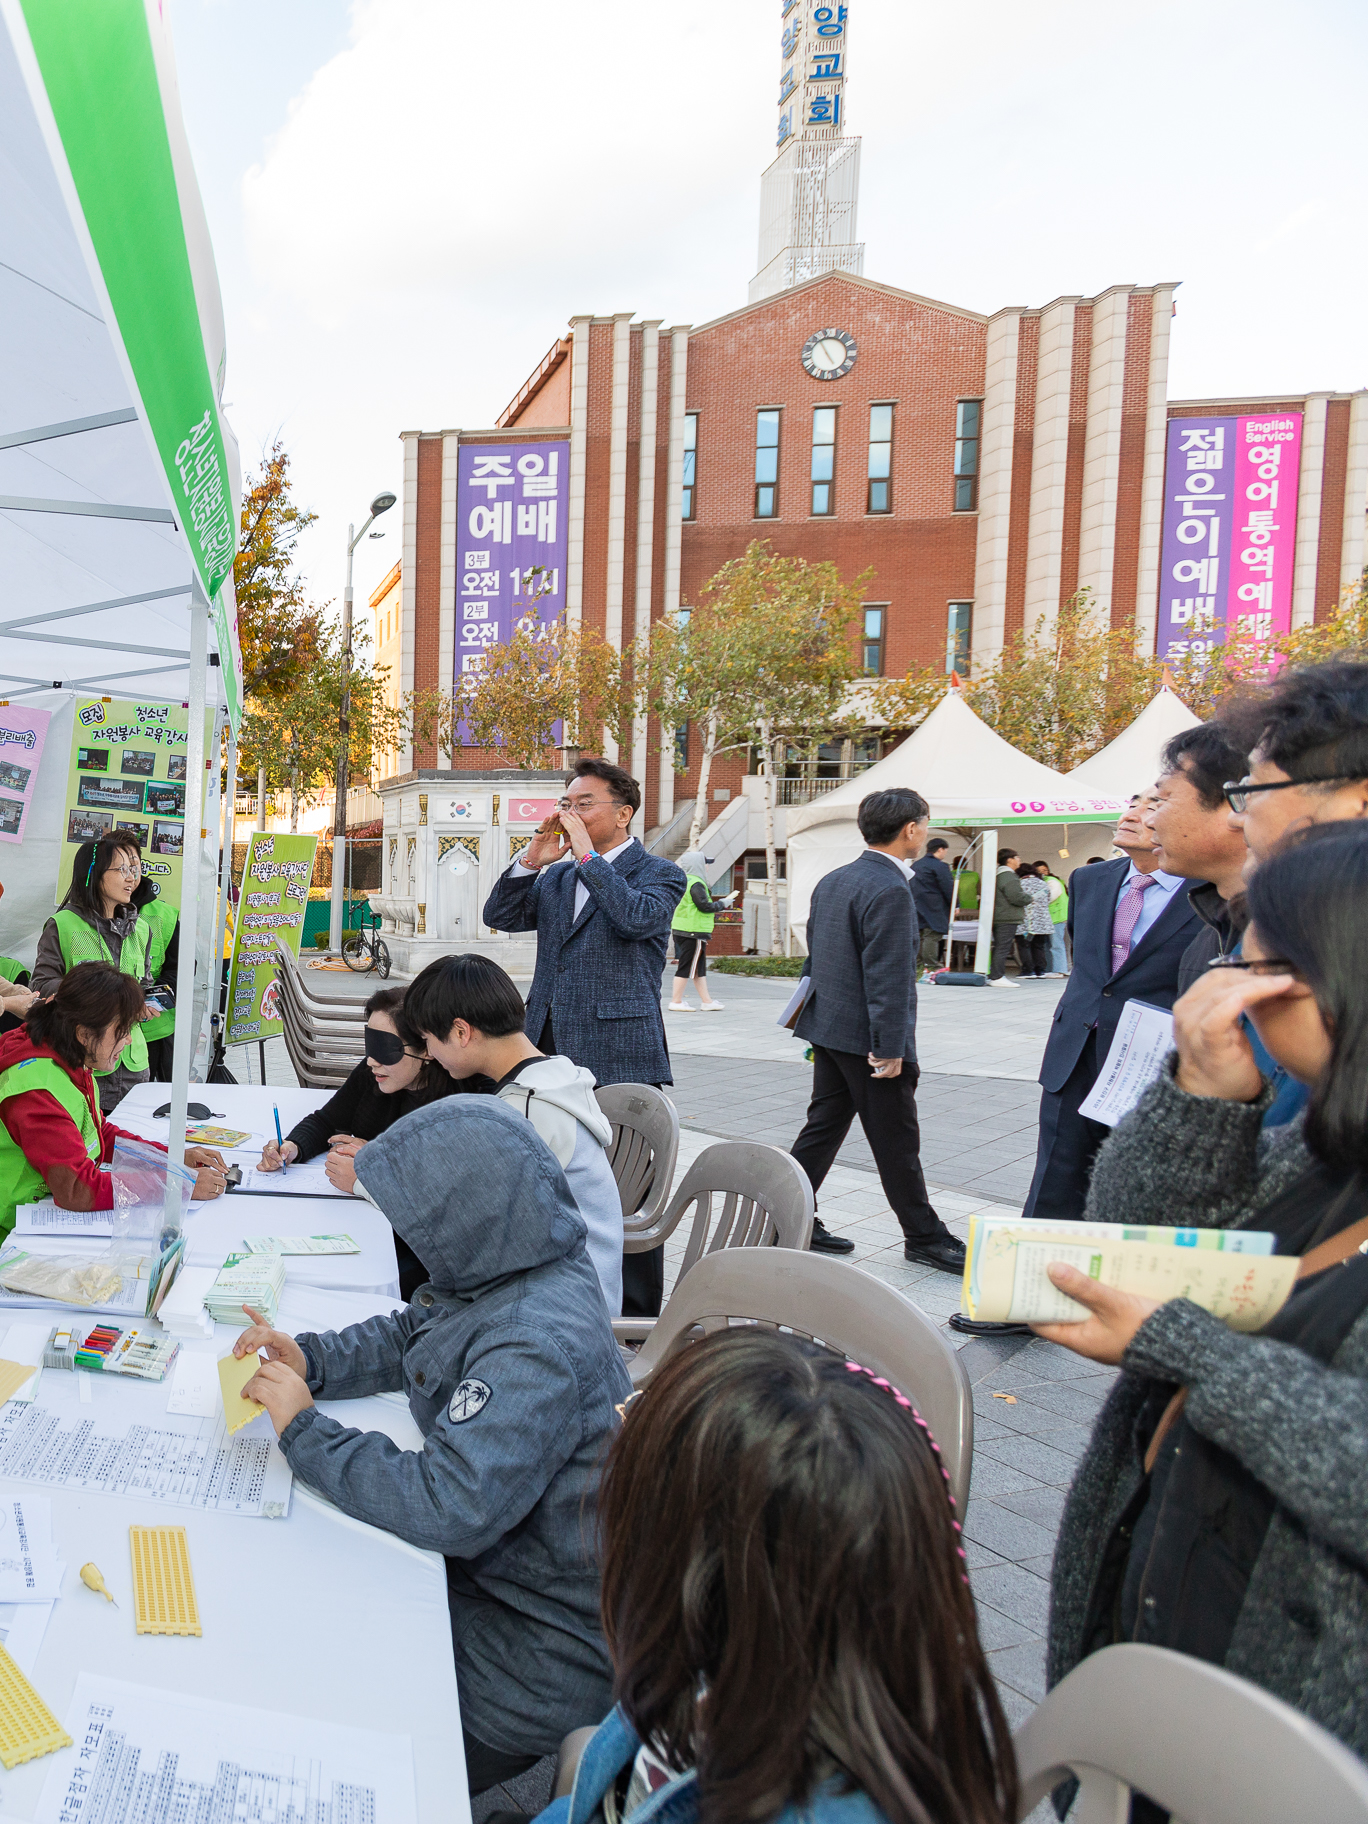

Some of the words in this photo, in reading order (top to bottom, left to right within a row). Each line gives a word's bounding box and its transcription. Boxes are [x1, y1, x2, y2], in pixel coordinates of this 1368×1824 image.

[1245, 419, 1295, 433] English
[1245, 430, 1295, 443] Service
[468, 451, 559, 499] 주일
[468, 499, 558, 544] 예배
[467, 553, 487, 567] 3부
[461, 569, 500, 596] 오전
[467, 604, 485, 617] 2부
[459, 621, 499, 648] 오전
[82, 705, 103, 723] 모집
[135, 706, 168, 723] 청소년
[93, 725, 141, 742] 자원봉사
[255, 836, 274, 860] 청소년
[251, 862, 279, 881] 자원봉사
[281, 861, 309, 880] 교육강사단
[287, 882, 307, 904] 프로그램
[59, 1767, 92, 1823] 한글점자
[80, 1722, 105, 1761] 자모표
